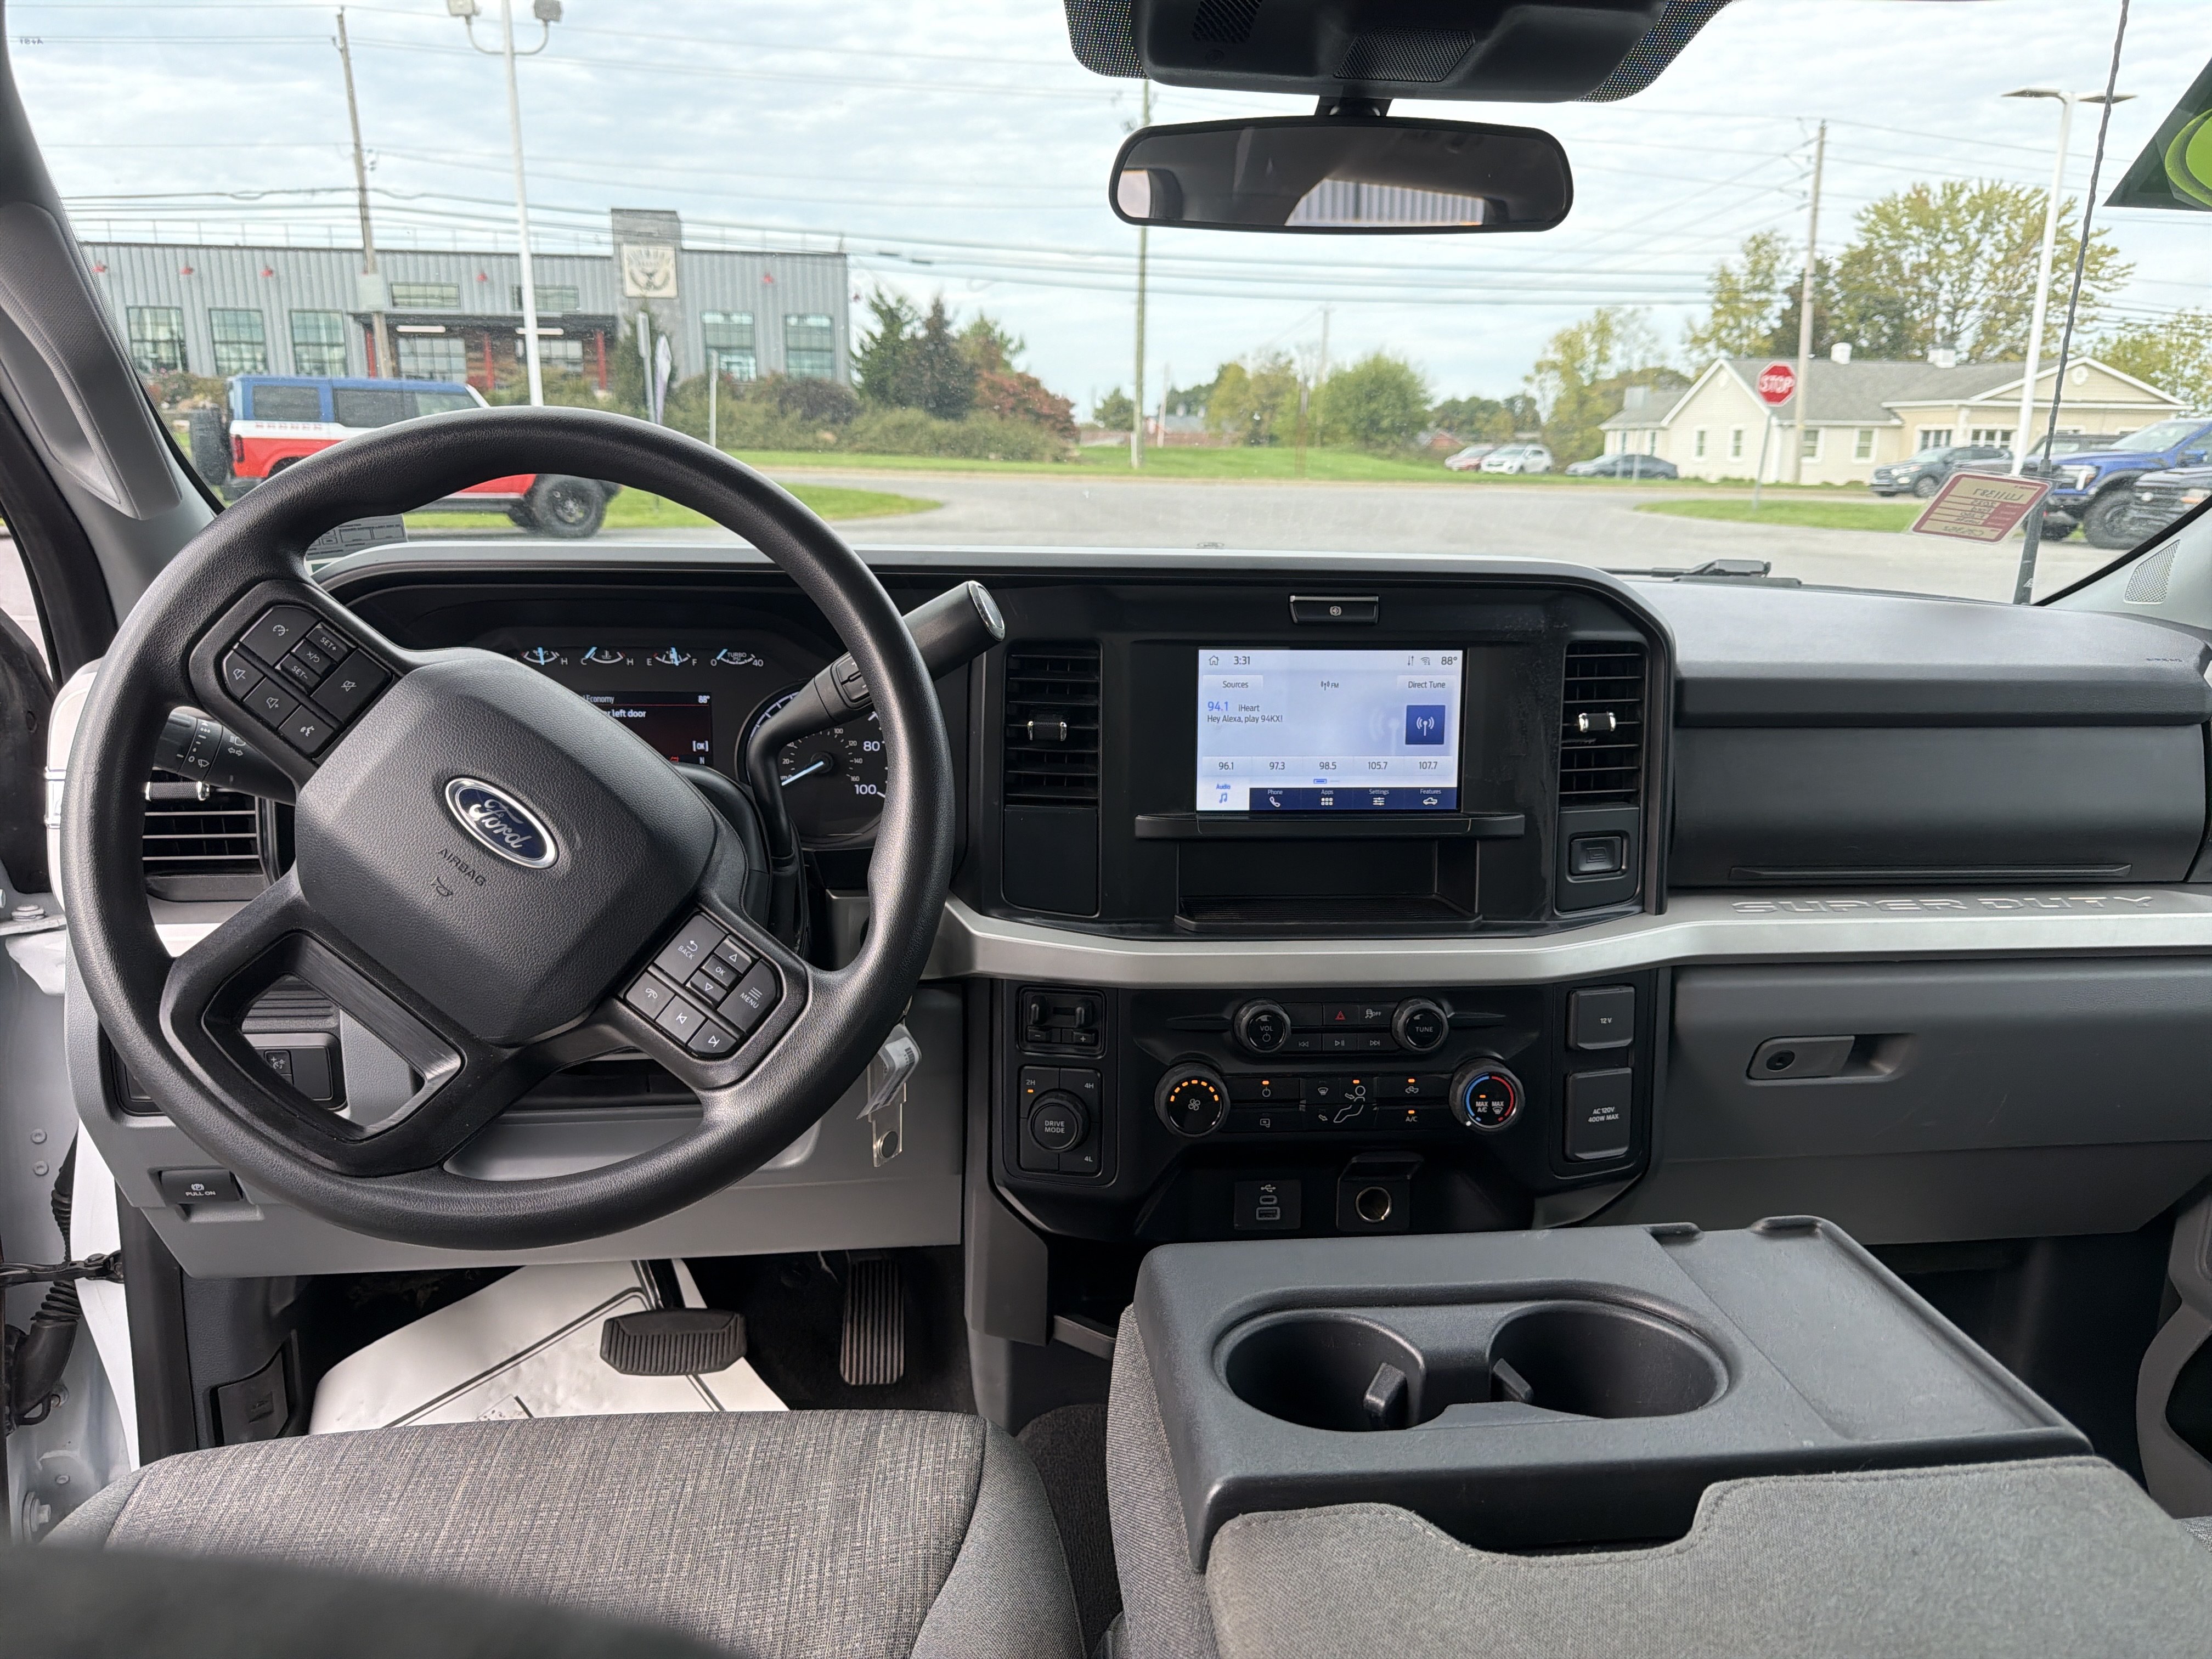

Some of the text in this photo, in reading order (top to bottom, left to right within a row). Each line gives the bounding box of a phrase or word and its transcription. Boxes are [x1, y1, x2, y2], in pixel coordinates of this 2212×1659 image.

[1759, 375, 1795, 394] STOP
[1234, 656, 1251, 665] 3:31
[1441, 656, 1458, 665] 88°
[1222, 680, 1249, 689] Sources
[586, 695, 614, 704] Economy
[1207, 701, 1229, 711] 94.1
[612, 709, 626, 718] left
[628, 709, 646, 718] door
[1207, 715, 1220, 724] Hey
[1222, 715, 1243, 723] Alexa,
[1244, 715, 1259, 724] play
[863, 741, 880, 751] 80
[1218, 761, 1234, 770] 96.1
[1269, 761, 1285, 770] 97.3
[1319, 761, 1336, 770] 98.5
[1368, 761, 1387, 770] 105.7
[1419, 761, 1437, 770] 107.7
[855, 784, 876, 794] 100
[469, 799, 532, 848] Ford
[438, 848, 487, 886] AIRBAG
[1732, 896, 2154, 913] SUPER DUTY
[678, 945, 694, 961] BACK
[715, 966, 726, 976] OK
[740, 992, 759, 1009] MENU
